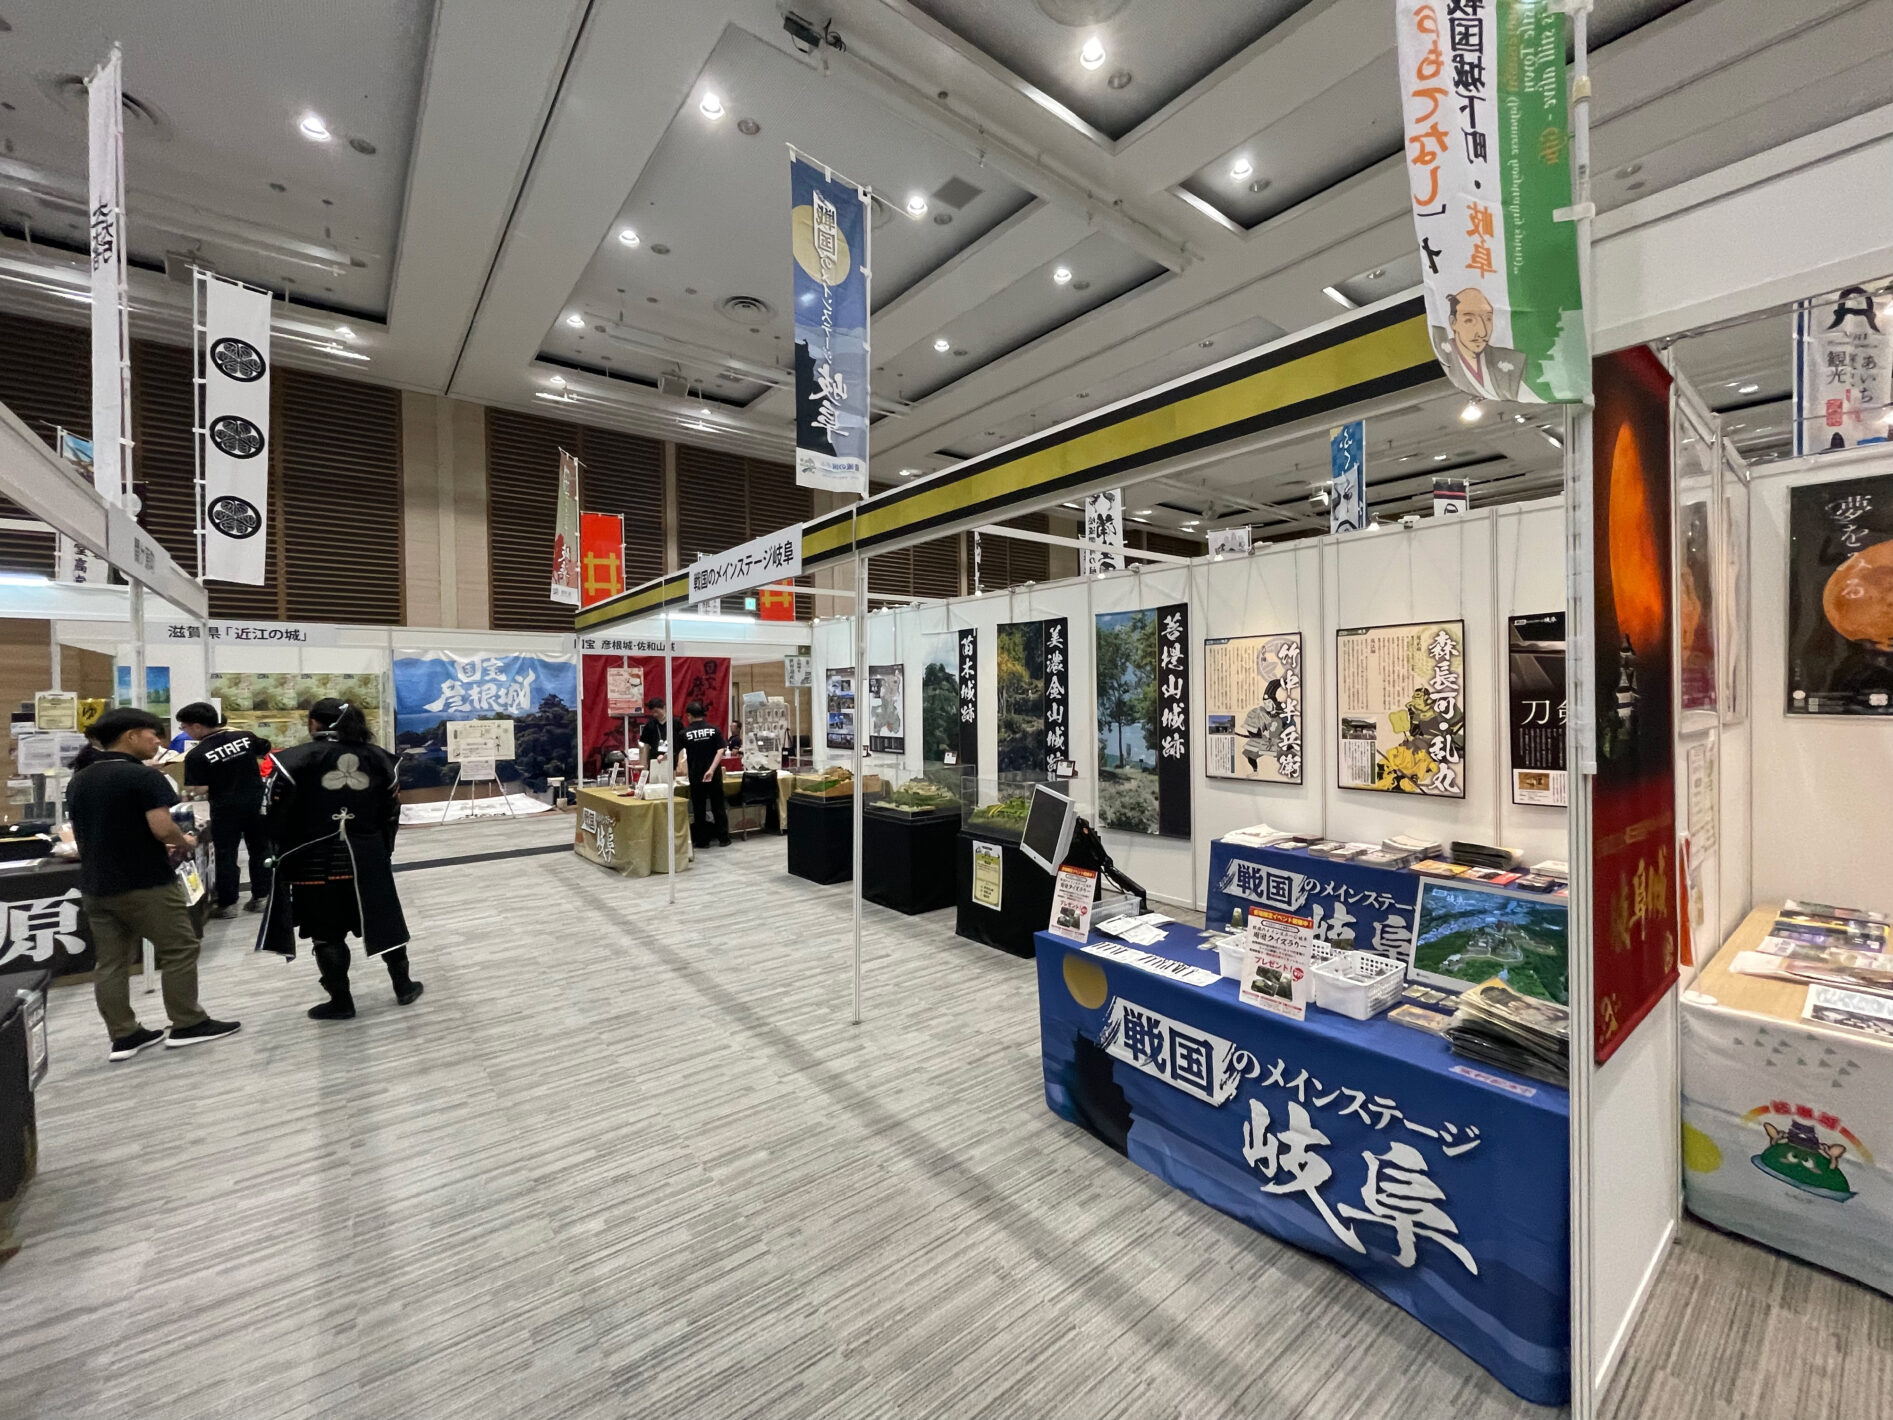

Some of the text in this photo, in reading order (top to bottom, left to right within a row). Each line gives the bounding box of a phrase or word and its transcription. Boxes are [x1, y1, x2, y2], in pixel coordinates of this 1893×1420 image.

[1826, 350, 1847, 385] 観光
[1859, 354, 1877, 403] あいち
[693, 540, 794, 591] 戦国のメインステージ岐阜
[168, 625, 307, 642] 滋賀県「近江の城」
[424, 668, 536, 714] 彦根城
[455, 657, 508, 683] 国宝
[961, 635, 975, 723] 苗木城跡
[1161, 612, 1185, 759] 菩提山城跡
[686, 728, 716, 741] STAFF
[1278, 642, 1301, 779] 竹中半兵衛
[1429, 630, 1461, 793] 森長可・乱丸
[205, 737, 251, 763] STAFF
[1236, 863, 1416, 911] 戦国のメインステー
[0, 888, 86, 965] 原
[1122, 1006, 1482, 1157] 戦国のメインステージ
[1242, 1098, 1479, 1276] 岐阜
